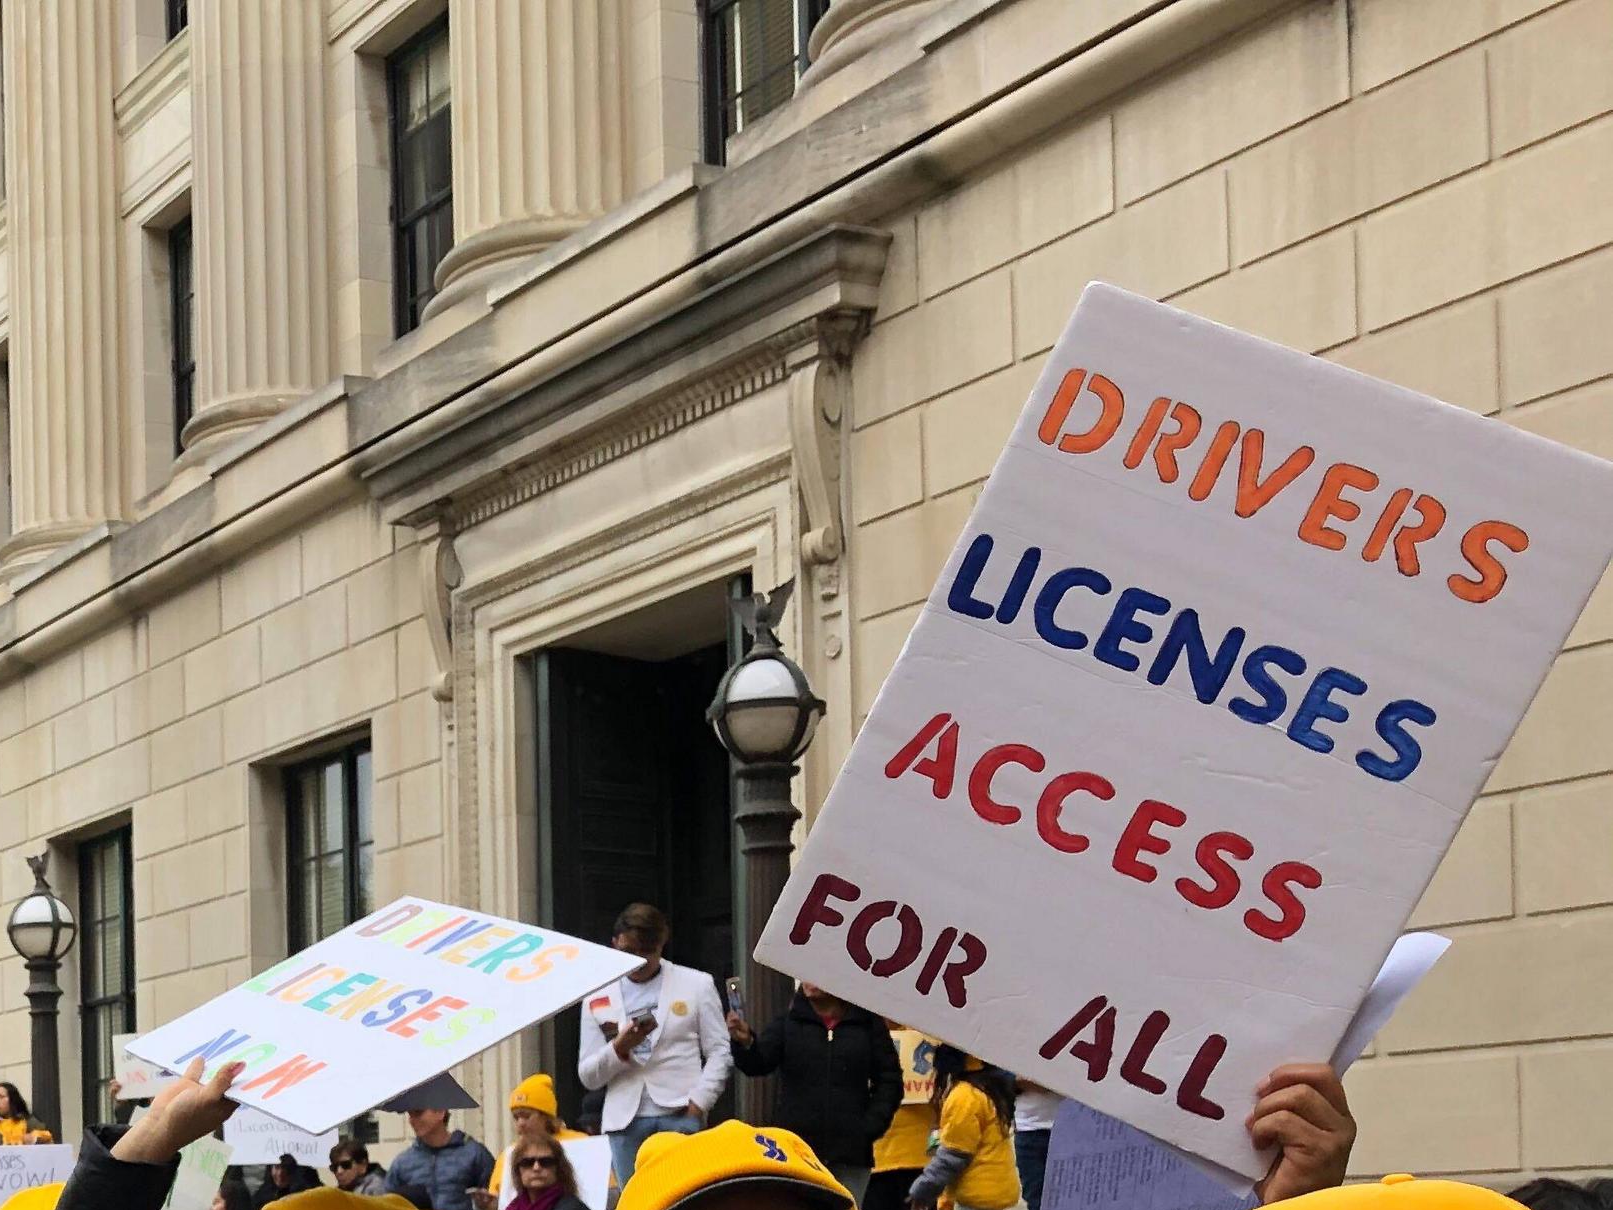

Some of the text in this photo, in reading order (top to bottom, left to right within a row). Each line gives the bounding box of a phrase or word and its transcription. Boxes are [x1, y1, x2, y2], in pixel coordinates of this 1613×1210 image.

[1038, 367, 1529, 603] DRIVERS
[947, 533, 1437, 783] LICENSES
[884, 712, 1323, 943] ACCESS
[243, 956, 498, 1048] LICENSES
[354, 904, 580, 984] DRIVERS
[789, 873, 1227, 1122] FOR ALL
[173, 1029, 328, 1100] NOW
